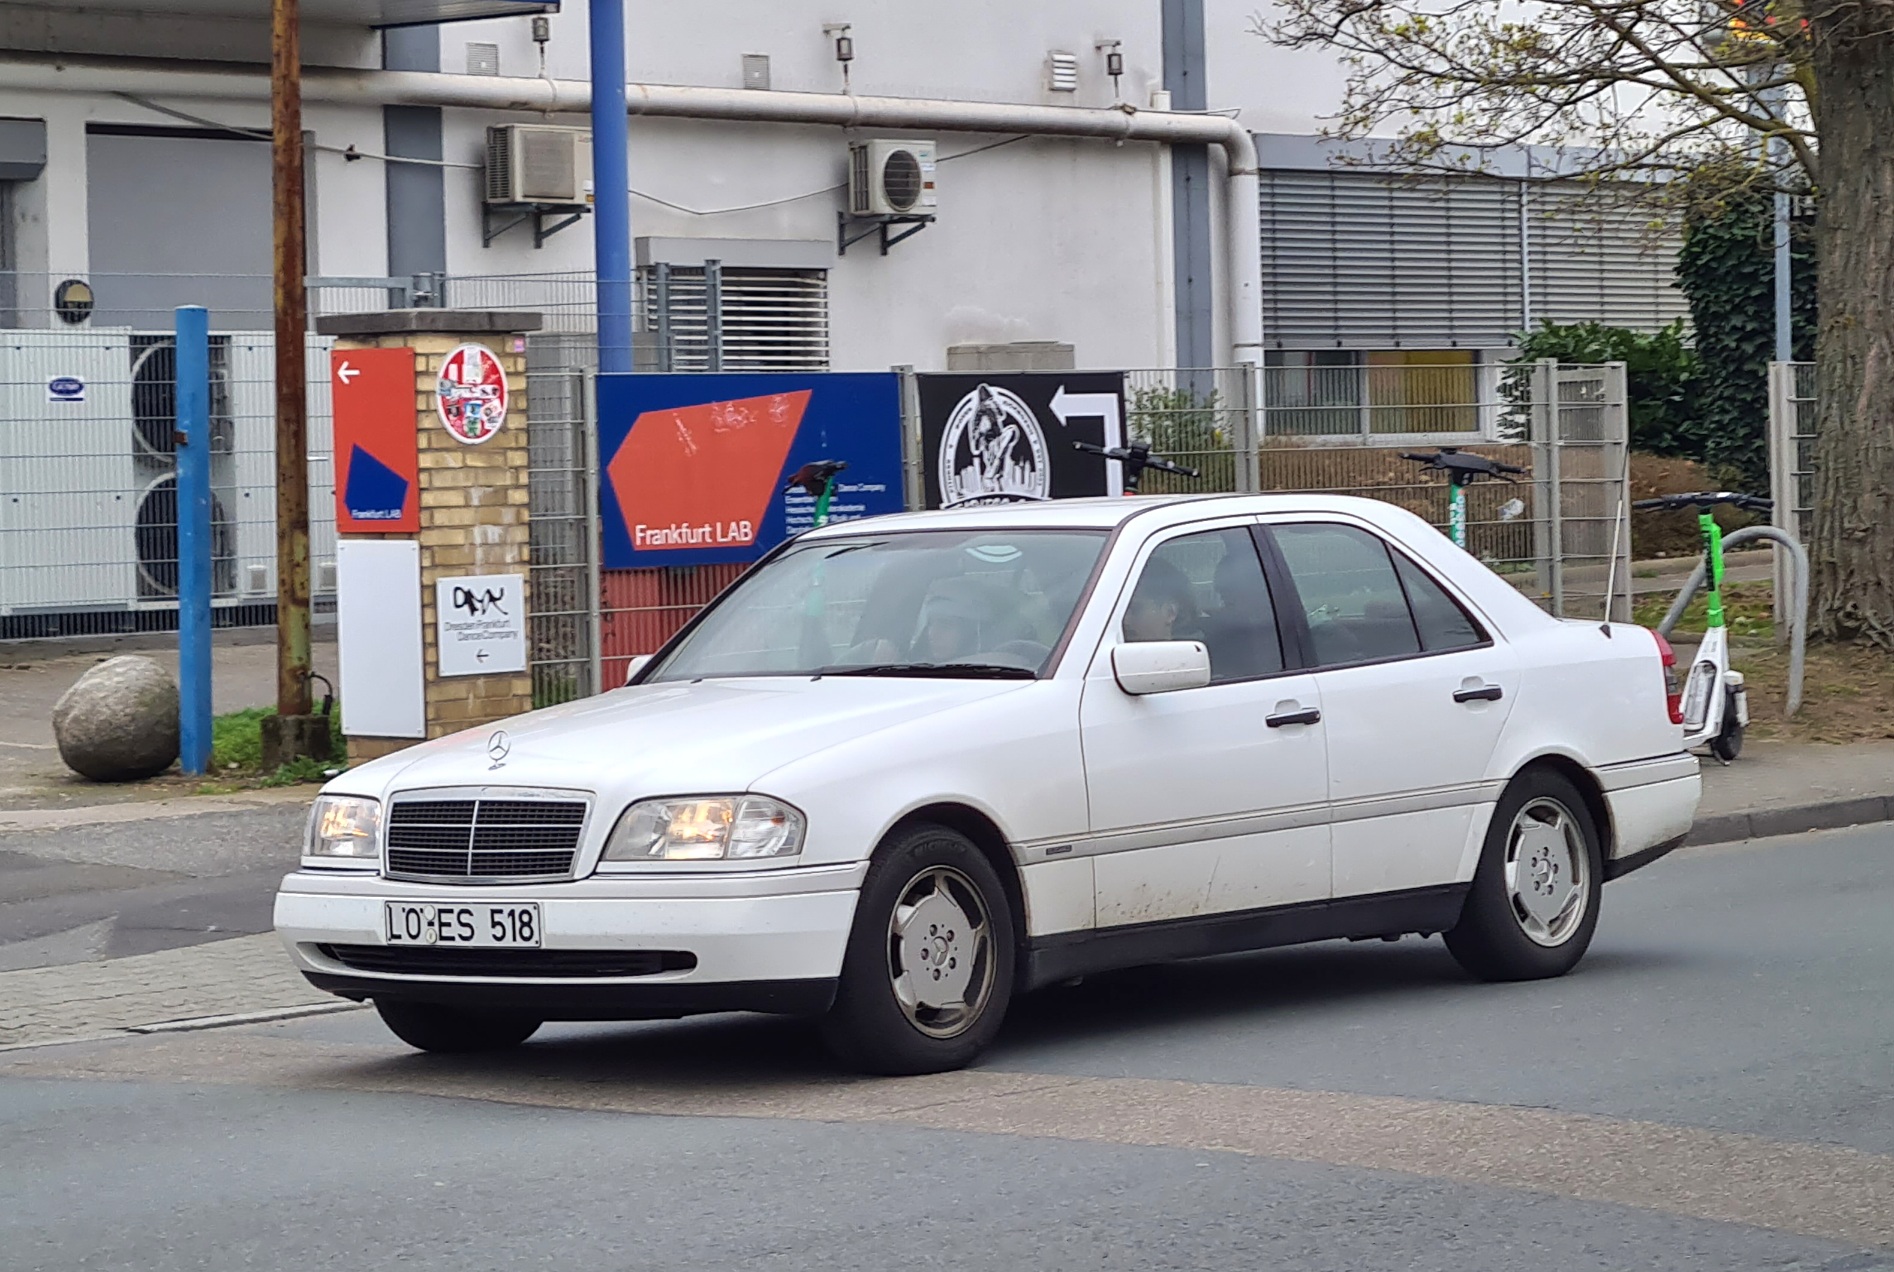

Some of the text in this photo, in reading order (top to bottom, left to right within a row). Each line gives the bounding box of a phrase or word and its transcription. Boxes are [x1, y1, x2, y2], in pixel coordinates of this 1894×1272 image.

[635, 520, 753, 546] Frankfurt LAB
[490, 908, 535, 942] 518
